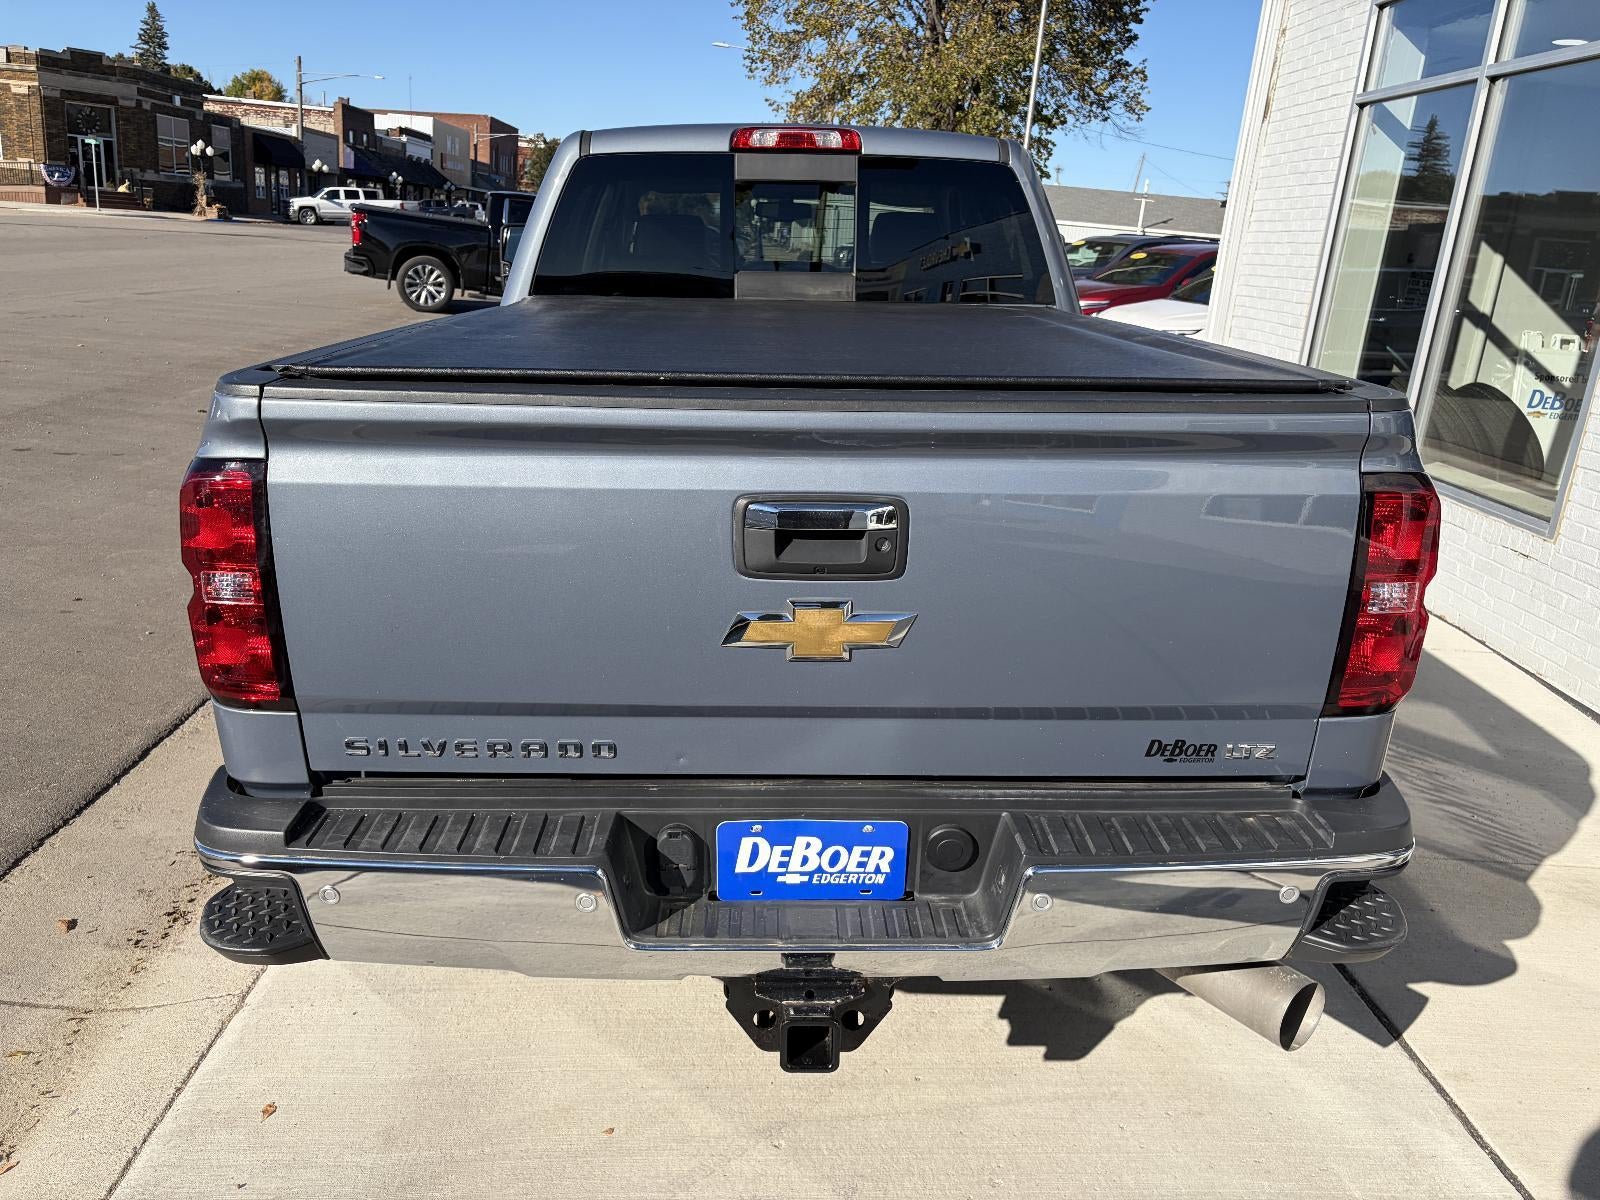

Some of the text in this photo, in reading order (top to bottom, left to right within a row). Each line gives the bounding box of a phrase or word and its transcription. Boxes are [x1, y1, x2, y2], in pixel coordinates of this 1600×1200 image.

[1535, 371, 1579, 385] Sponsored
[344, 736, 618, 759] SILVERADO
[1224, 743, 1277, 760] LTZ
[812, 873, 885, 884] EDGERTON
